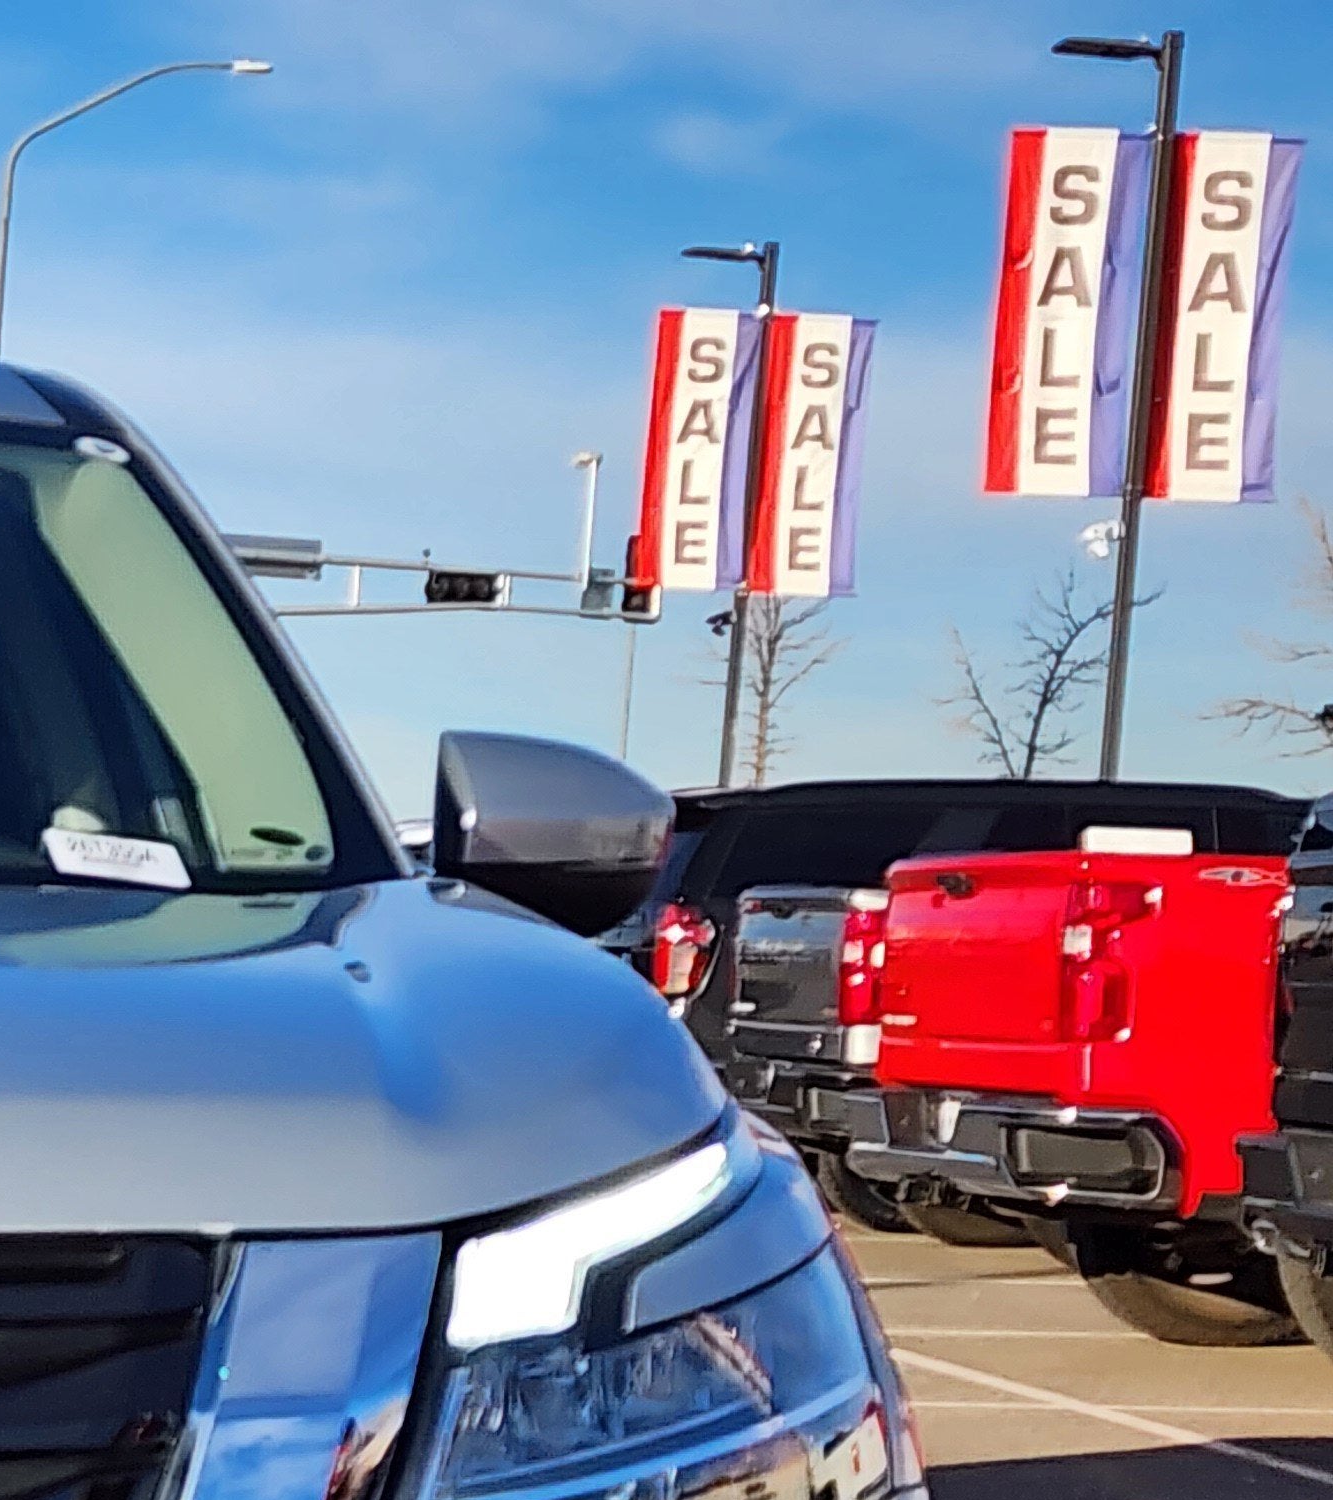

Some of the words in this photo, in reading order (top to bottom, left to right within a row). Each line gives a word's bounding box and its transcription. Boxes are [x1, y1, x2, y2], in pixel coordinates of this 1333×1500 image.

[1034, 165, 1101, 466] SALE
[1184, 170, 1256, 472] SALE
[674, 337, 727, 566] SALE
[788, 342, 841, 572] SALE
